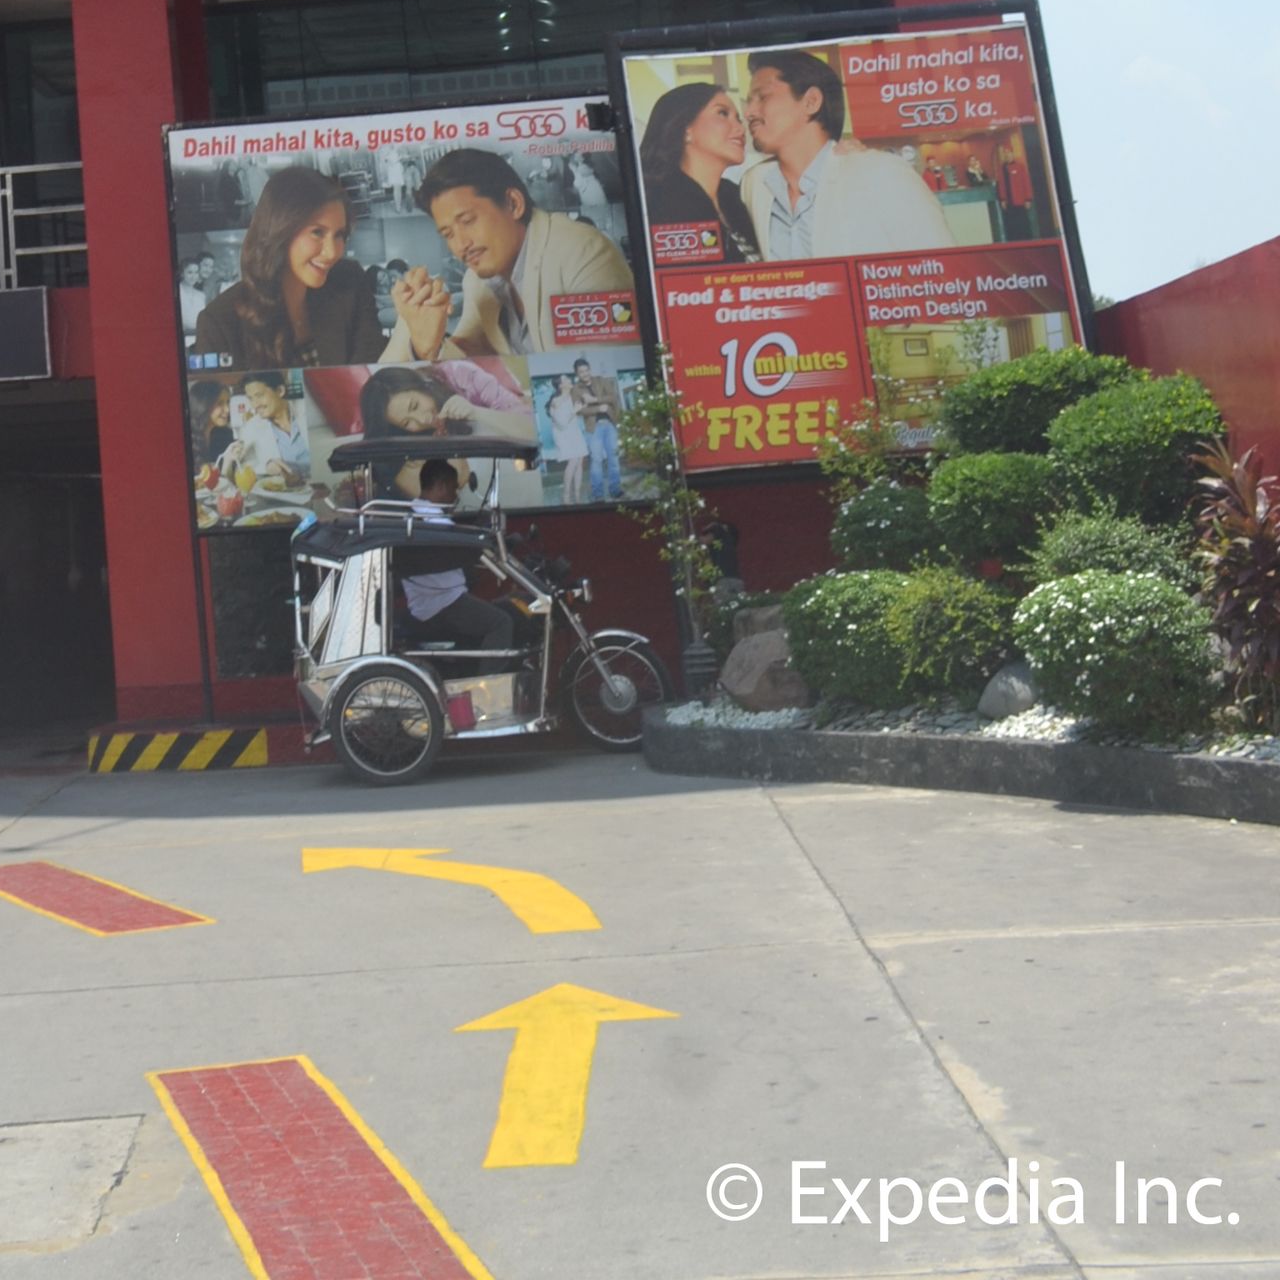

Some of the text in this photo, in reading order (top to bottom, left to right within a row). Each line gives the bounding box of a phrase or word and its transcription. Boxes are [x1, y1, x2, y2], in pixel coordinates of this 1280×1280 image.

[848, 44, 1024, 75] Dahil mahal kita,
[880, 73, 1001, 103] gusto ko sa
[898, 98, 998, 128] SOGO ka.
[183, 134, 236, 158] Dahil
[243, 129, 306, 154] mahal
[313, 127, 360, 150] kita,
[367, 124, 426, 151] gusto
[433, 120, 459, 140] ko
[465, 120, 490, 137] sa
[496, 107, 566, 141] SOGO
[654, 229, 698, 251] SOGO
[757, 272, 781, 282] serve
[784, 270, 805, 280] your
[862, 260, 945, 280] Now with
[668, 281, 829, 307] Food & Beverage
[864, 273, 1048, 301] Distinctively Modern
[554, 301, 608, 328] SOGO
[715, 304, 783, 323] Orders
[869, 299, 988, 321] Room Design
[684, 331, 849, 398] within 10 minutes
[706, 398, 839, 451] FREE!
